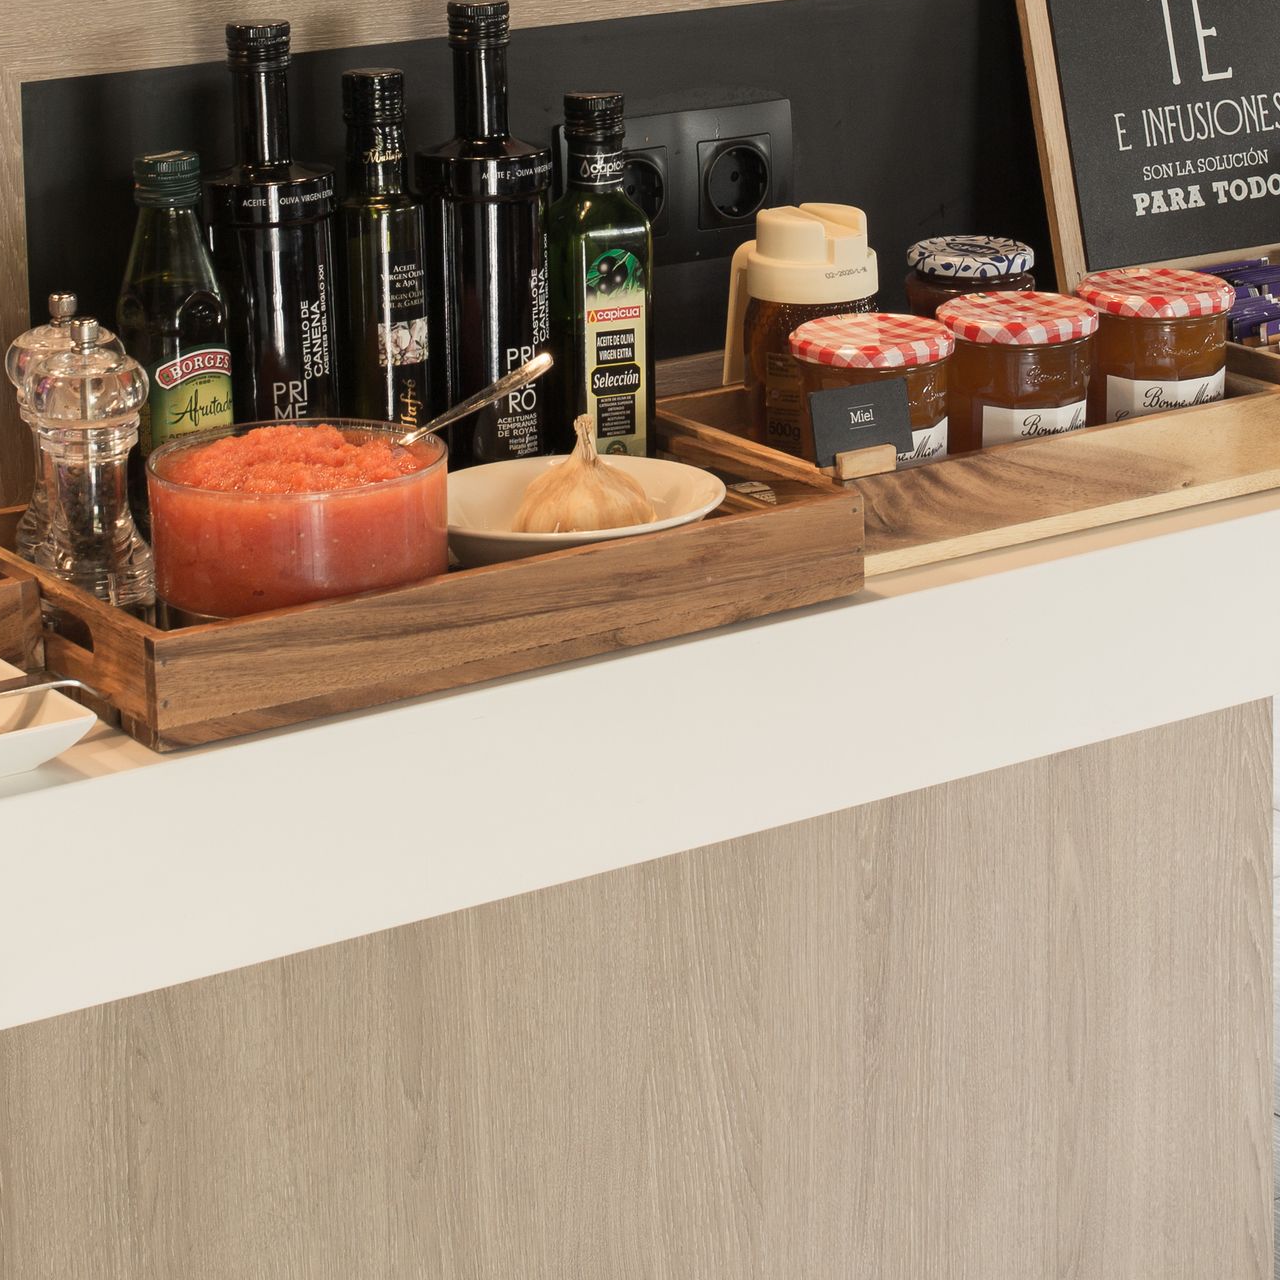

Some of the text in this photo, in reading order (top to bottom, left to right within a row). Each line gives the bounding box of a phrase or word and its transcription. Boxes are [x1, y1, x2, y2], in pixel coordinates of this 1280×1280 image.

[1114, 112, 1132, 151] E
[1143, 147, 1269, 181] SON LA SOLUCIÓN
[243, 199, 267, 207] ACEITE
[280, 196, 299, 205] OLIVA
[301, 192, 322, 202] VIRGEN
[1132, 184, 1206, 216] PARA
[381, 273, 407, 281] VRGEN
[383, 293, 407, 301] VRGIN
[530, 268, 539, 345] CASTILLO DE
[538, 268, 546, 342] CANENA
[597, 307, 640, 321] capicua
[300, 300, 312, 380] CASTILLO DE
[310, 300, 324, 377] CANENA
[597, 333, 634, 347] ACEITE DE OLIVA
[599, 347, 632, 361] VIRGEN EXTRA
[169, 353, 231, 380] BORGES
[593, 369, 639, 389] Selección
[273, 380, 308, 404] PRI
[508, 389, 537, 413] RO
[1143, 386, 1188, 409] Bonne
[497, 420, 537, 431] TEMPRANAS
[498, 413, 537, 424] ACEITUNAS
[850, 409, 874, 424] Miel
[1021, 413, 1065, 437] Bonne
[498, 426, 537, 438] DE ROYAL
[769, 422, 801, 441] 500g
